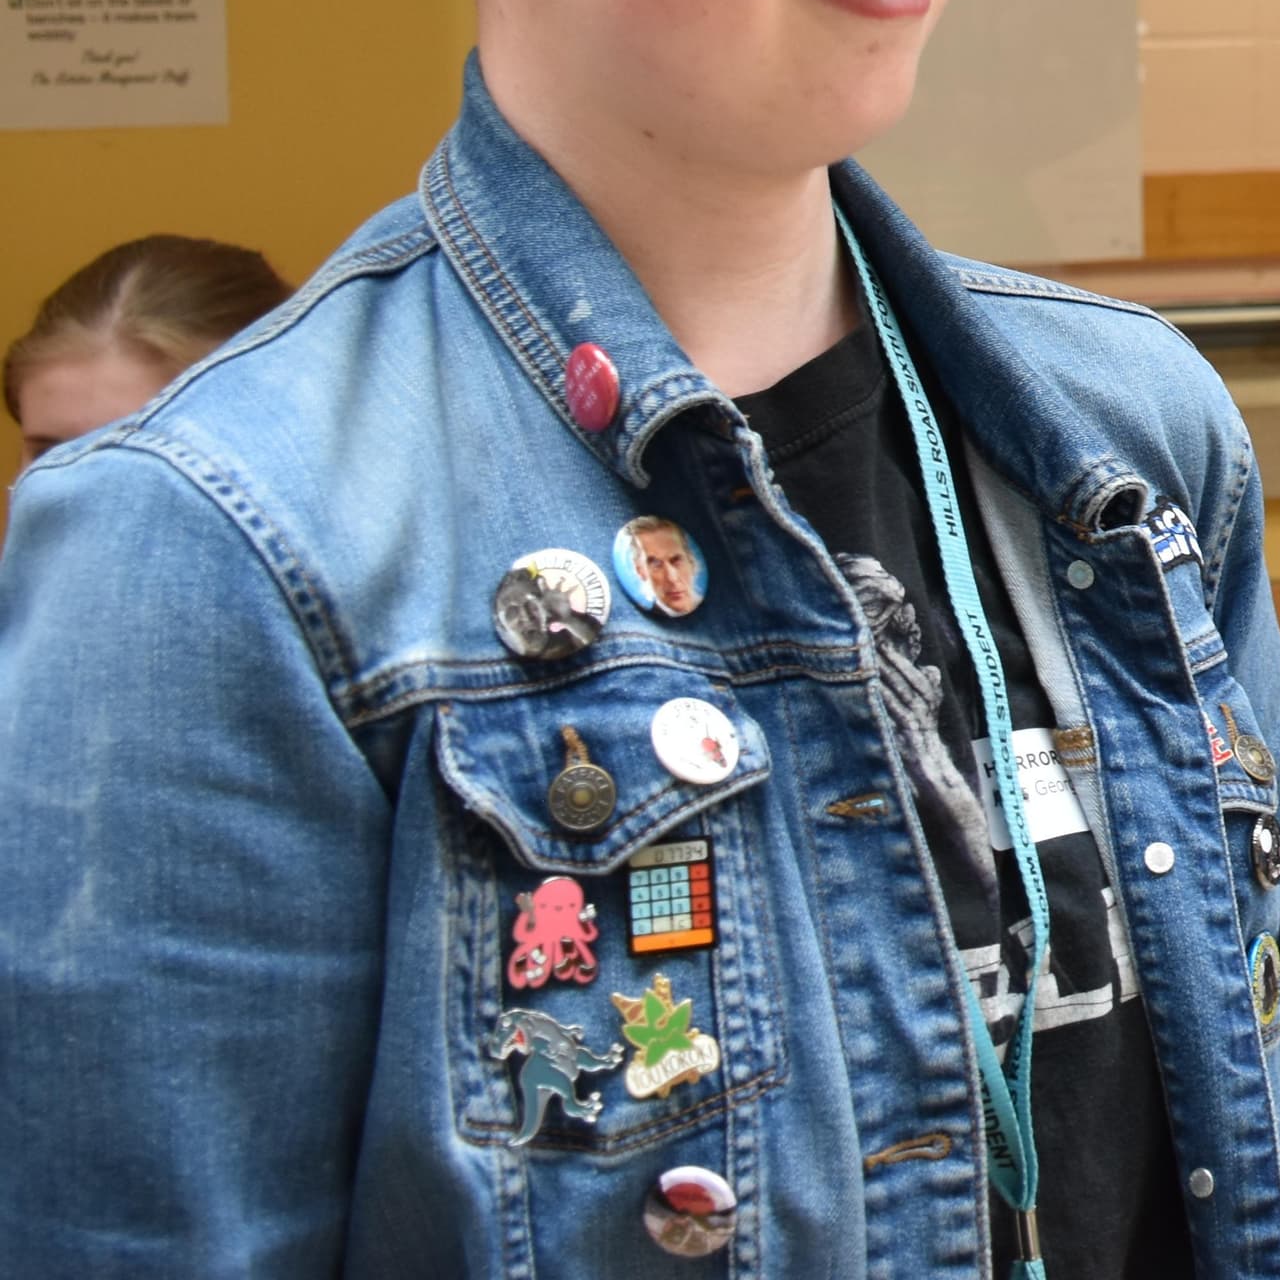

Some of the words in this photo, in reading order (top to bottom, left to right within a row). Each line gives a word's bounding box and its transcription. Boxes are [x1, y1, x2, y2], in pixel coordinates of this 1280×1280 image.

[887, 333, 919, 394] SIXTH
[915, 399, 943, 463] ROAD
[936, 471, 958, 537] HILLS
[965, 609, 1007, 720] STUDENT
[983, 749, 1061, 779] HRROR
